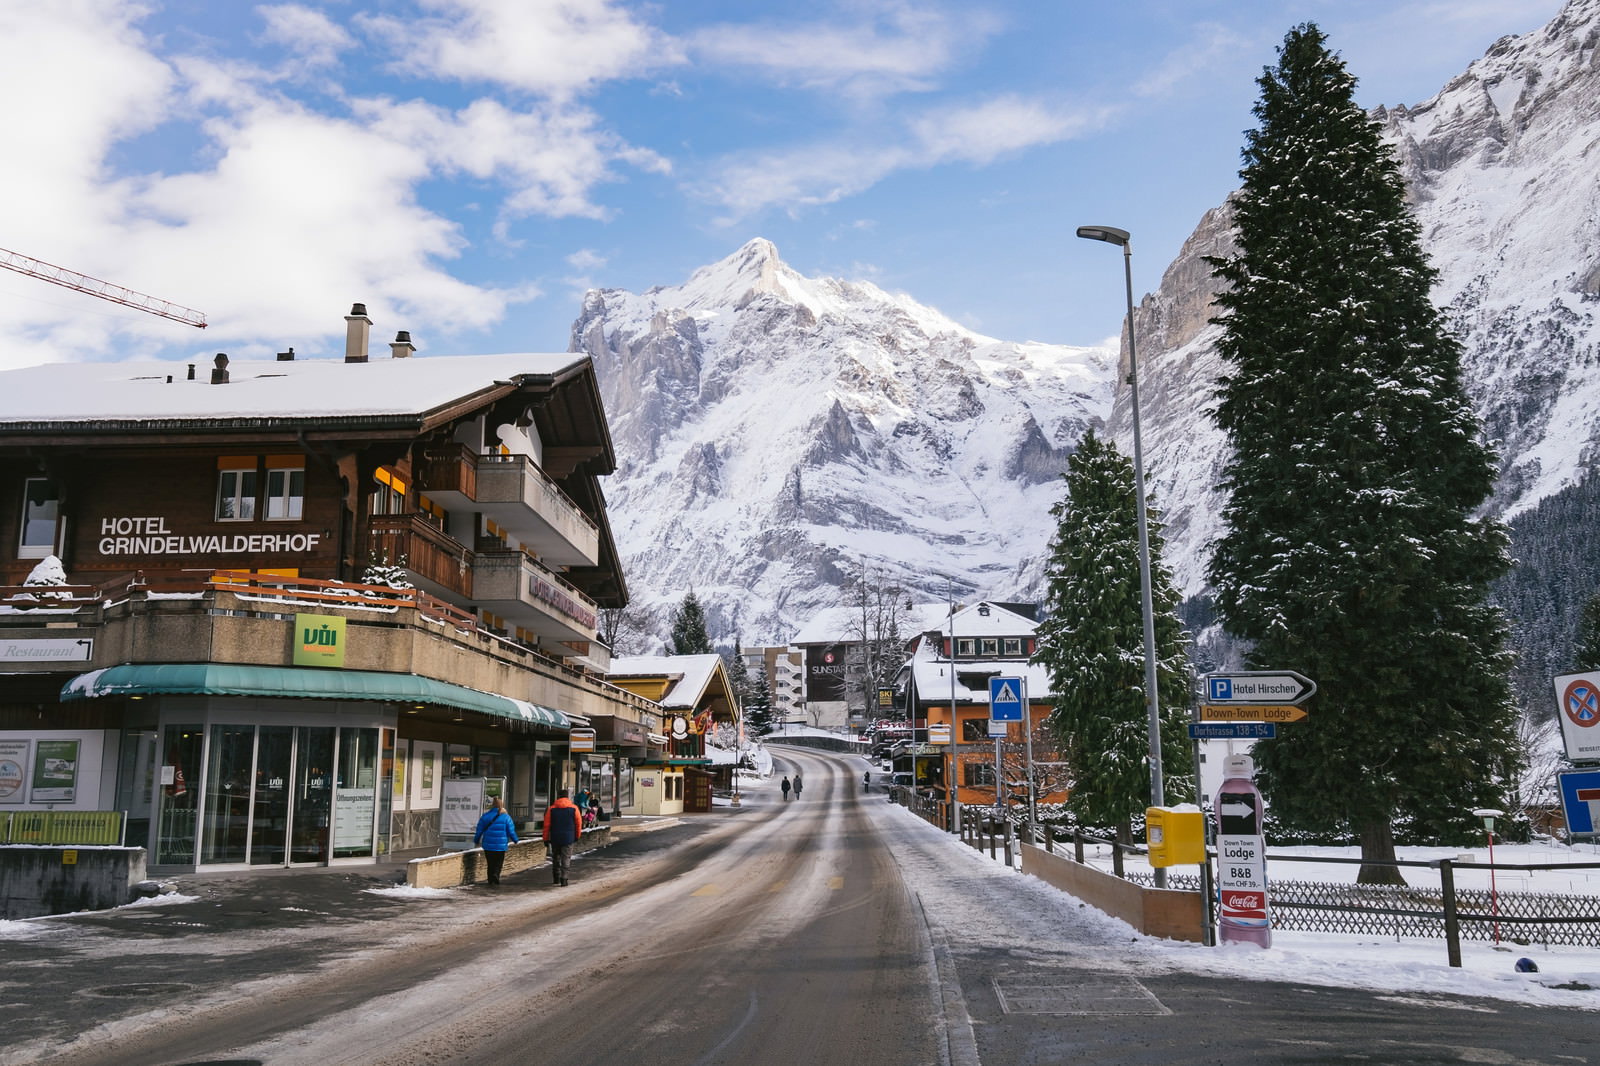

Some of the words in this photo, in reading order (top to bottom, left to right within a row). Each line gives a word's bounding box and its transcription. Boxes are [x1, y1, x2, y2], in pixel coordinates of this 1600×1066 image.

[101, 517, 171, 535] HOTEL
[99, 534, 320, 555] GRINDELWALDERHOF
[4, 645, 74, 657] Restaurant
[1216, 681, 1227, 697] P
[1233, 684, 1256, 694] Hotel
[1258, 683, 1296, 693] Hirschen
[1206, 708, 1260, 718] Down-Town
[1263, 708, 1292, 720] Lodge
[1194, 726, 1234, 736] Dorfstrasse
[1236, 725, 1268, 735] 138-154
[1225, 847, 1254, 860] Lodge
[1231, 868, 1251, 878] B&B
